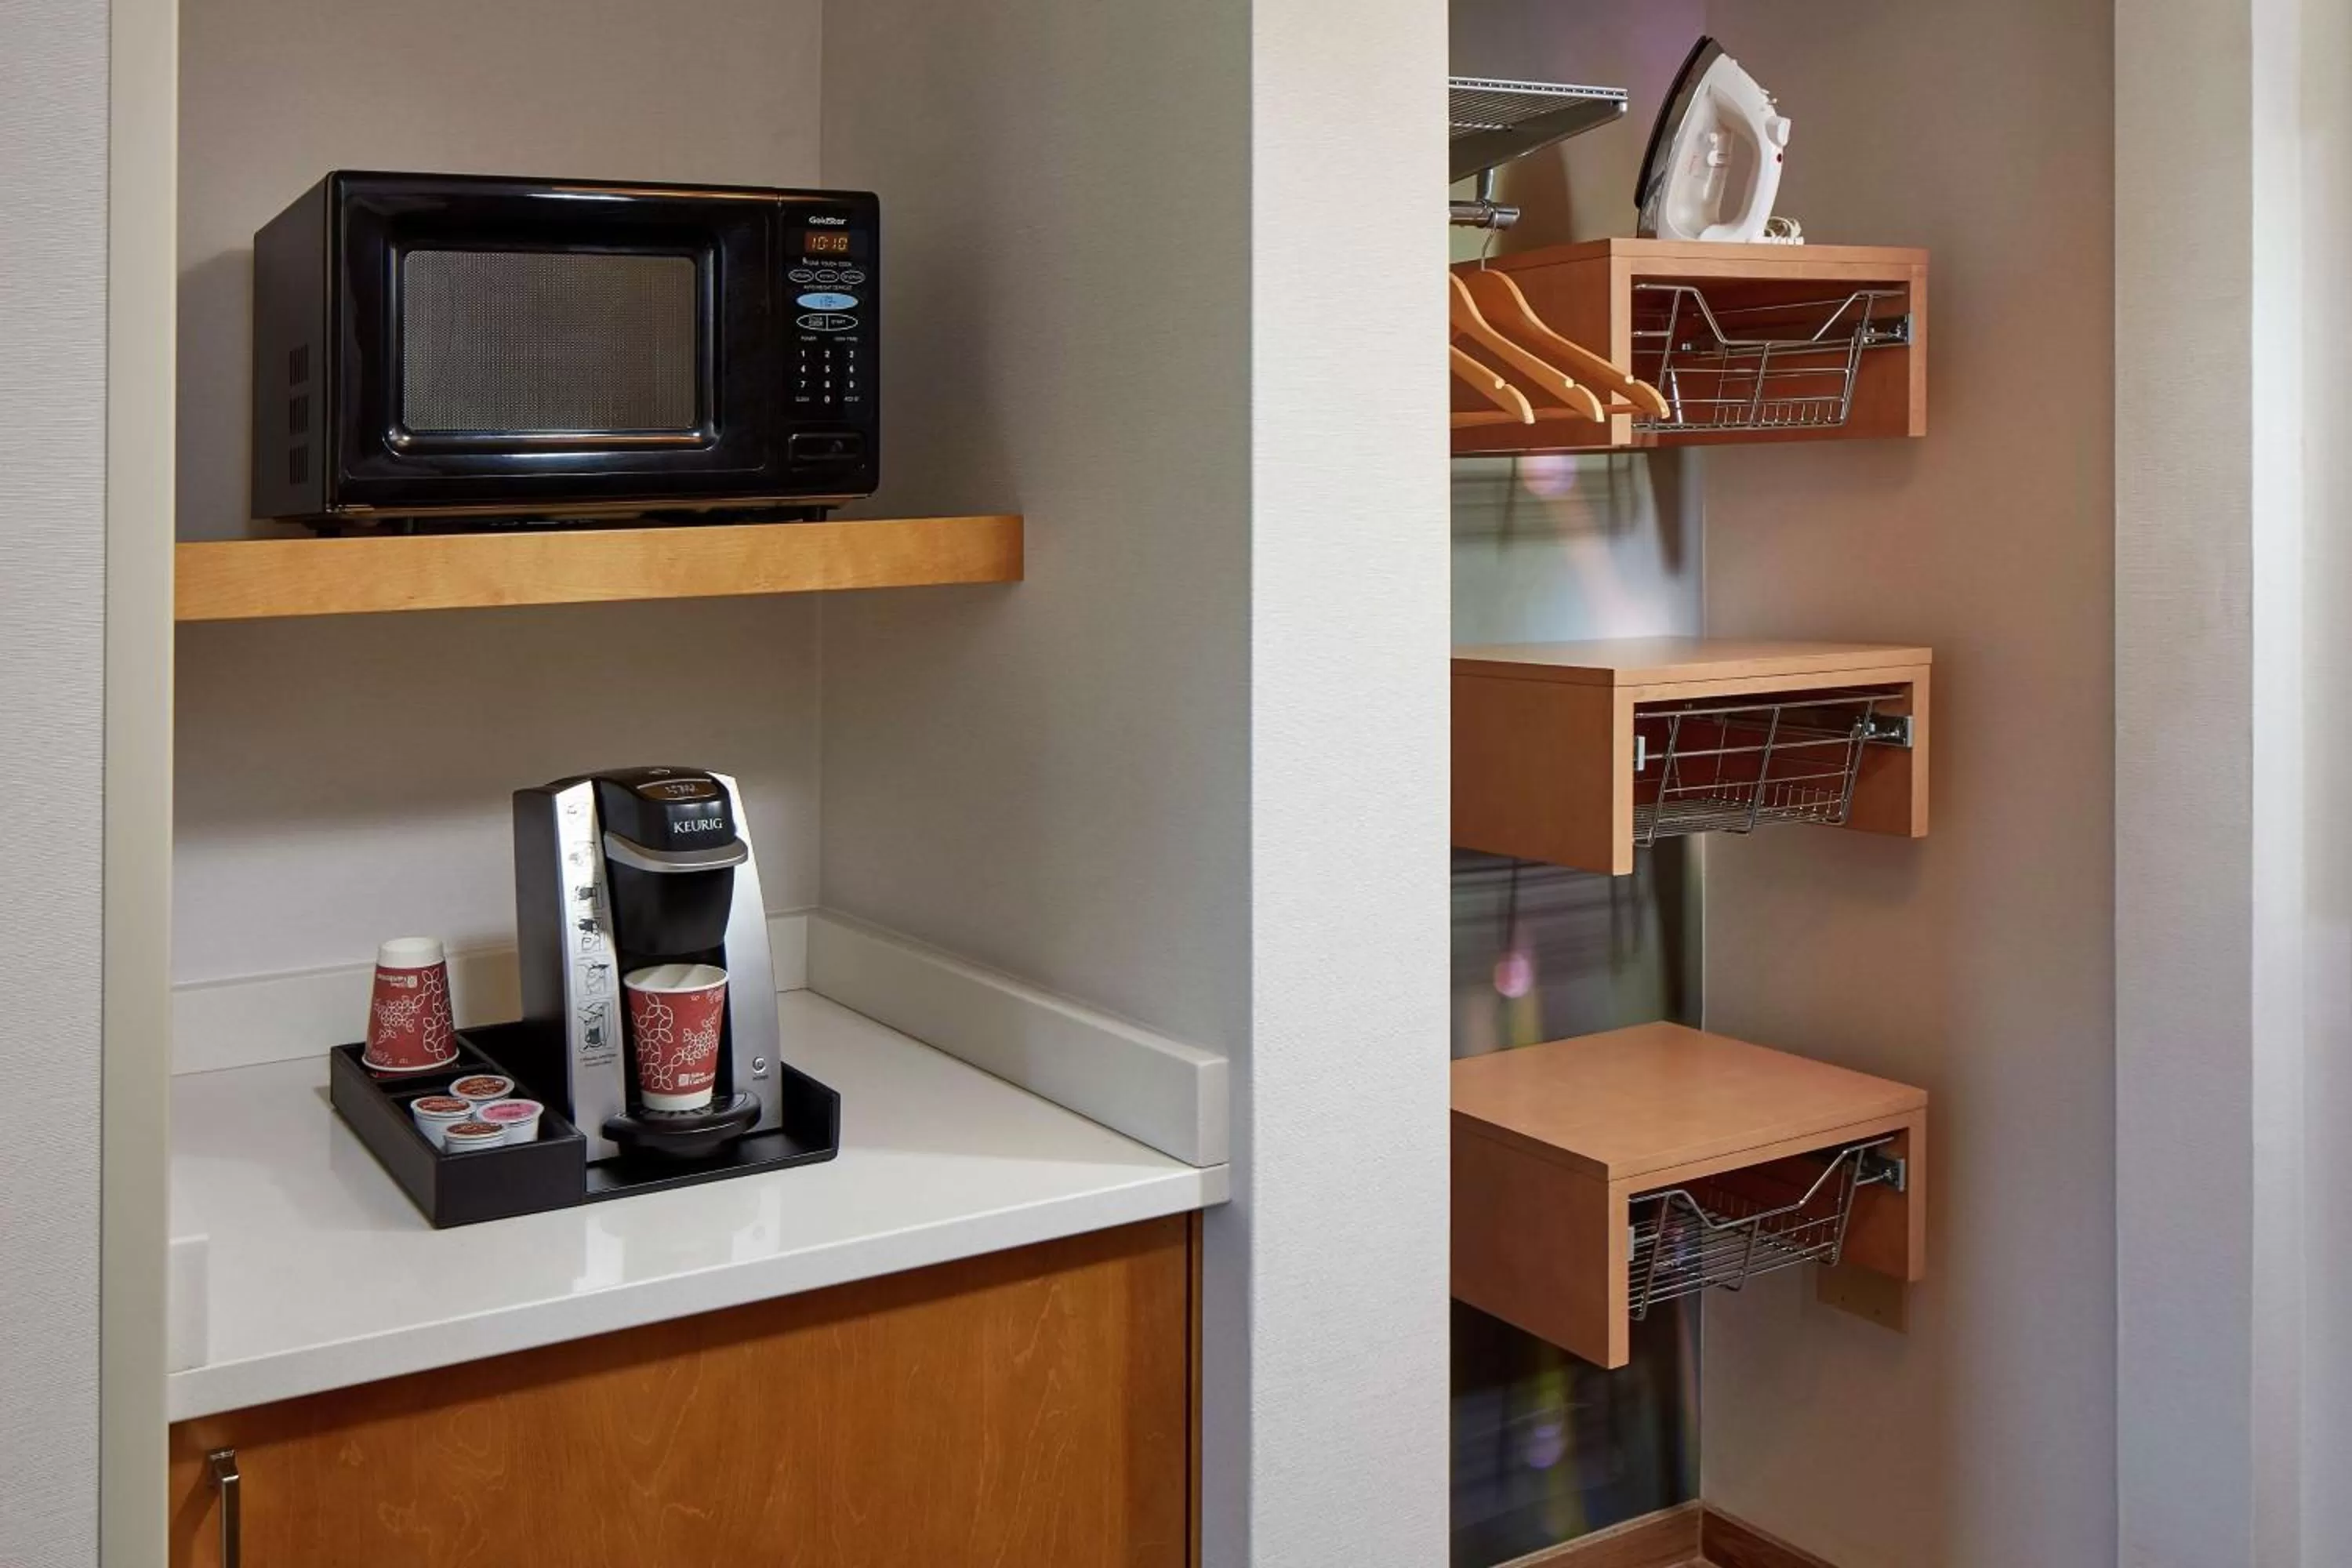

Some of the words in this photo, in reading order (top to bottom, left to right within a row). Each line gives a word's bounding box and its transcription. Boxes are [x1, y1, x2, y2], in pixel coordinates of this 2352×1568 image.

[809, 216, 847, 225] GoldStar
[811, 236, 848, 251] 10:10
[824, 350, 830, 358] 2
[800, 365, 806, 373] 4
[824, 365, 830, 373] 5
[849, 365, 854, 373] 6
[824, 395, 830, 404] 0
[673, 818, 722, 833] KEURIG
